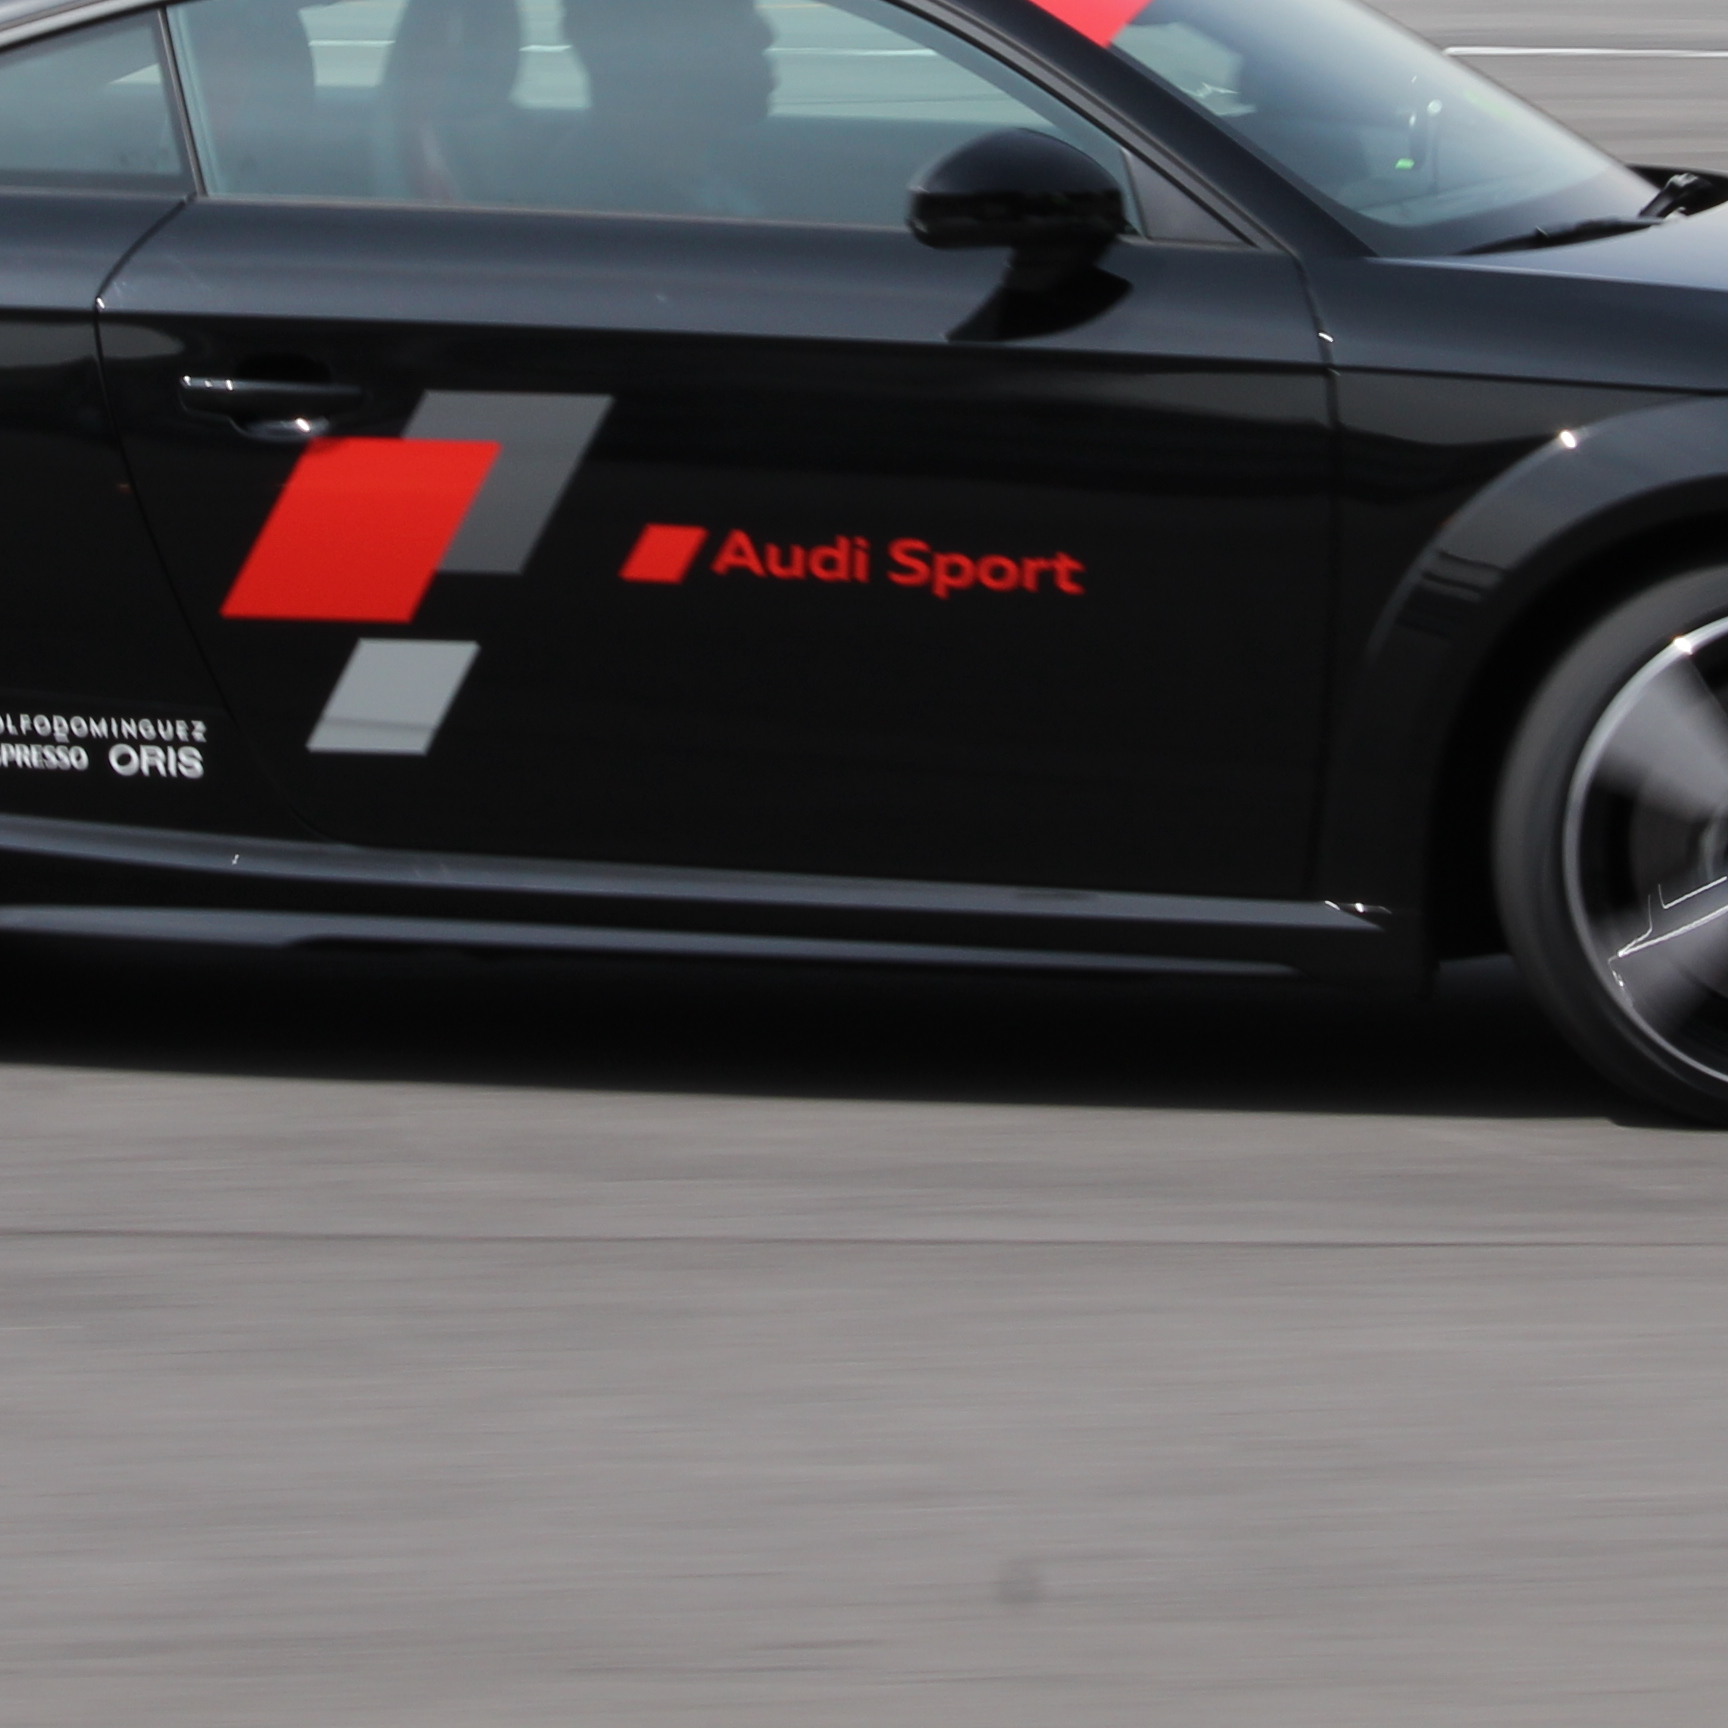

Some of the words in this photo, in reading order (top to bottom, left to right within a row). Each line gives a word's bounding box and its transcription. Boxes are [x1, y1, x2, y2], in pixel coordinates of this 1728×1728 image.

[710, 529, 871, 584] Audi
[886, 537, 1086, 600] Sport
[108, 743, 204, 779] ORIS
